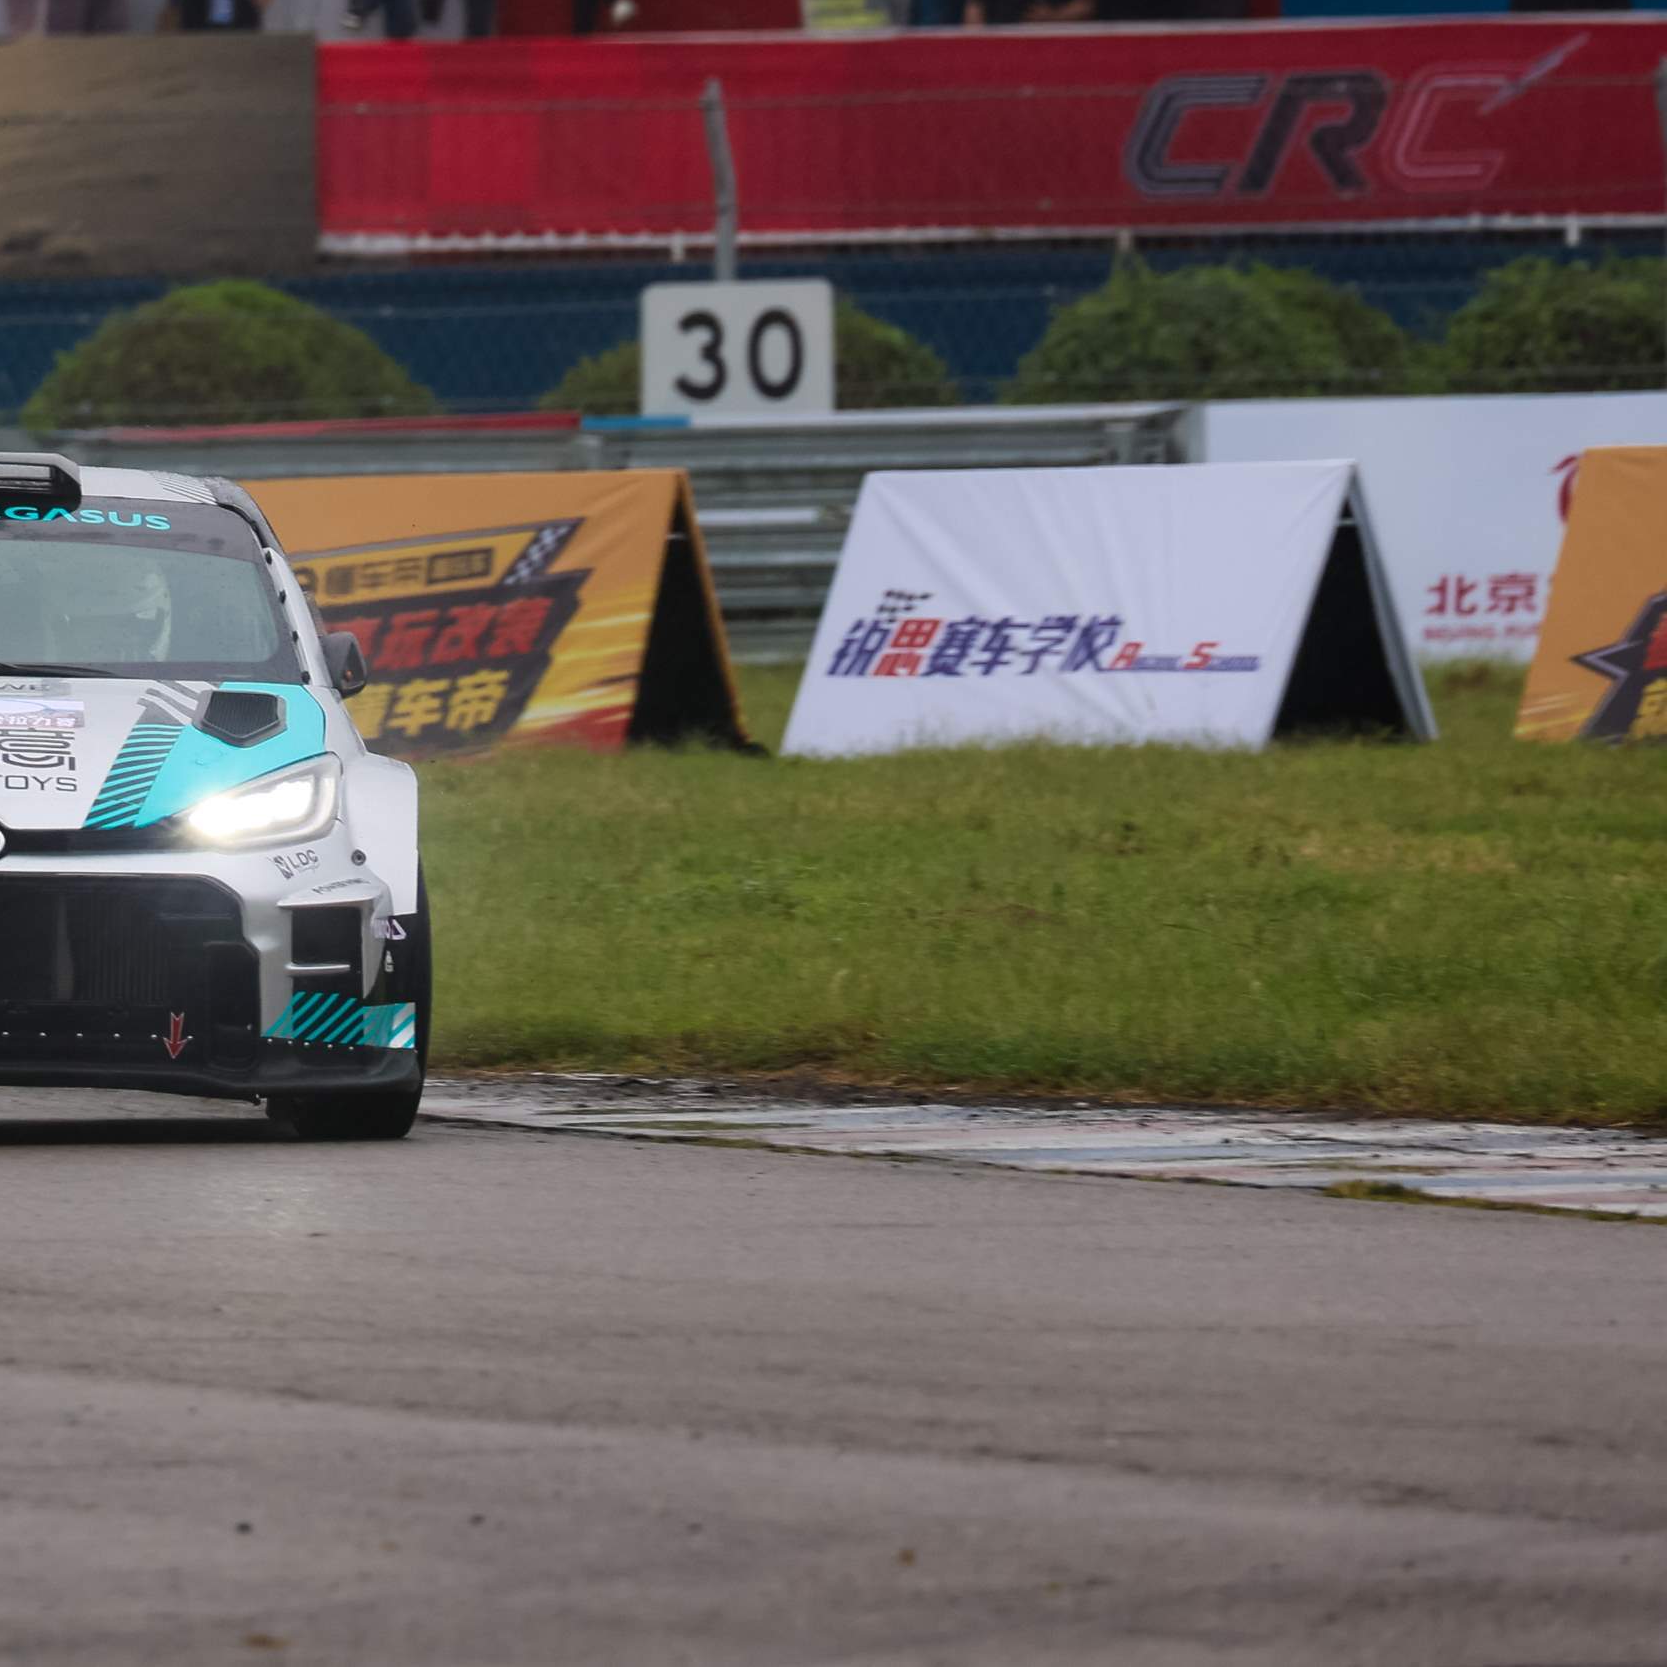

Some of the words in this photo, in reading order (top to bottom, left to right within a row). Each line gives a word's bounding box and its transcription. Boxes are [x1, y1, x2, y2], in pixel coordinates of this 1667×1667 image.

[1122, 66, 1517, 201] CRC
[674, 306, 805, 405] 30
[825, 614, 1125, 678] 锐思赛车学校
[286, 848, 319, 870] LDC
